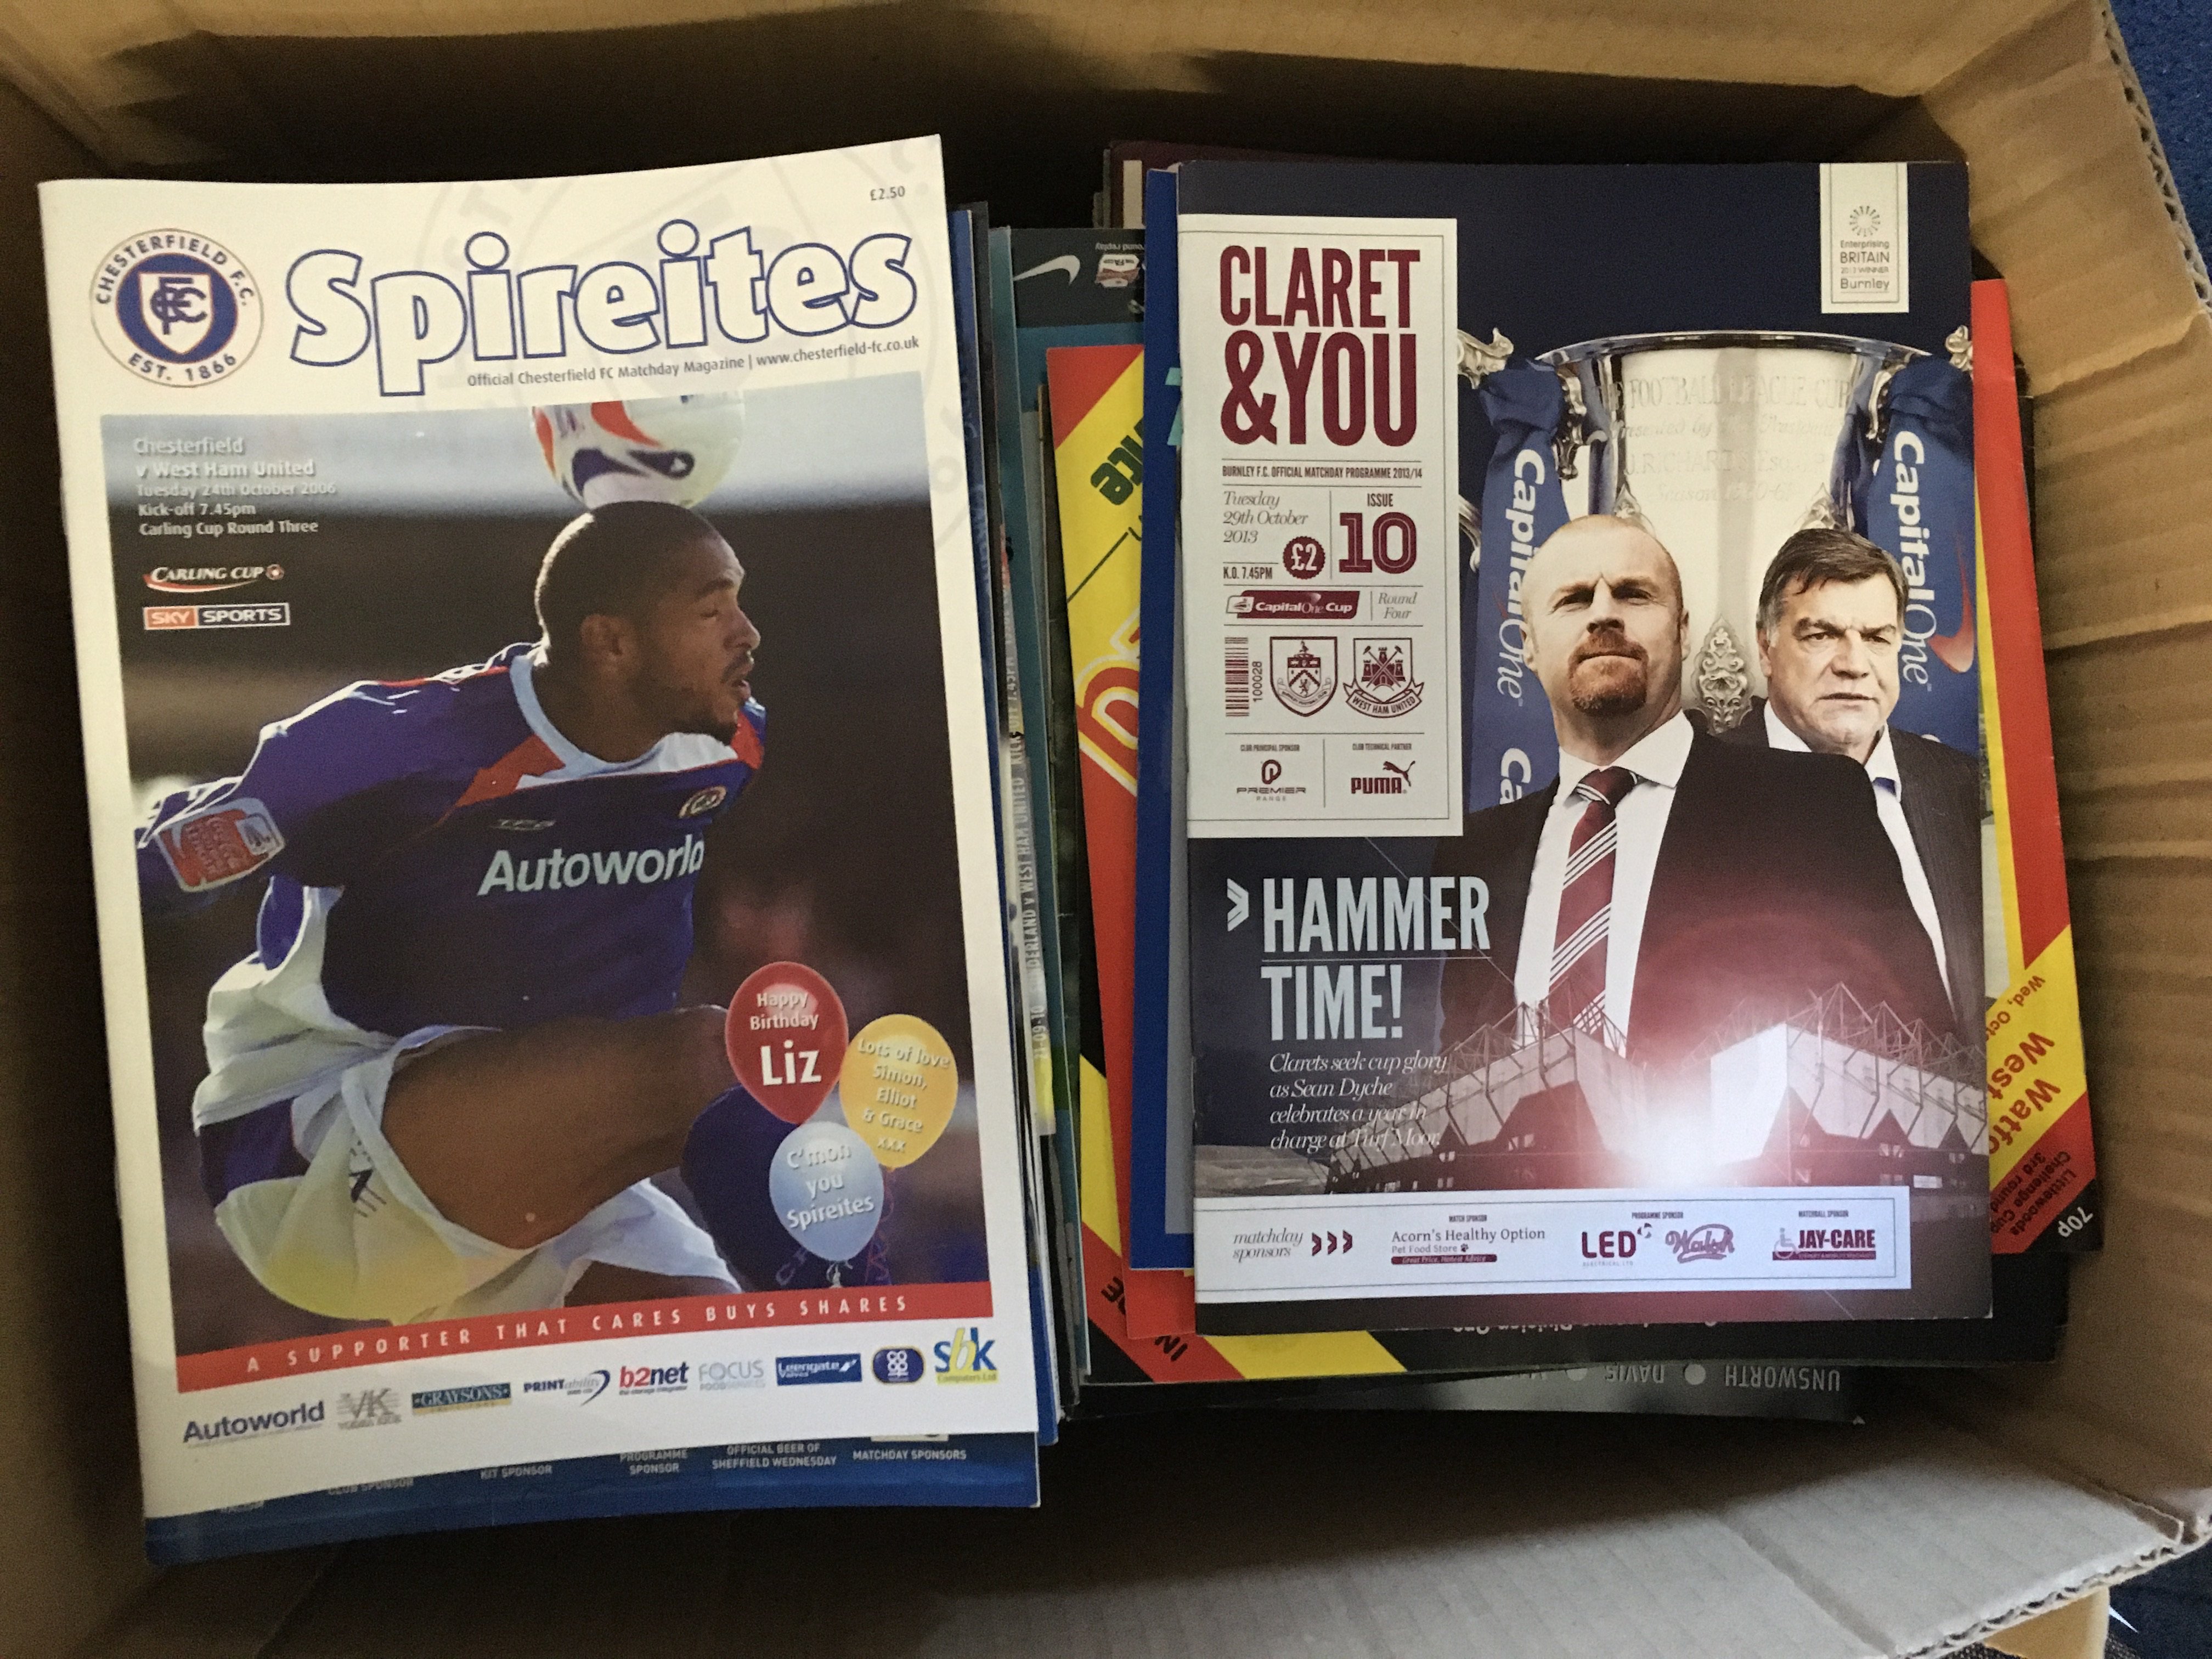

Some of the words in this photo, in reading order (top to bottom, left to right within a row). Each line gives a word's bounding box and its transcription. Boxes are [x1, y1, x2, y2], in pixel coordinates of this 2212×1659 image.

[870, 184, 905, 201] £2.50
[1841, 240, 1890, 250] Enterprising
[1841, 251, 1890, 263] BRITAIN
[95, 234, 227, 306] CHESTERFIELD
[229, 269, 255, 307] F.C.
[1220, 244, 1421, 329] CLARET
[1841, 278, 1890, 290] Burnley
[285, 218, 917, 397] Spireites
[127, 351, 172, 382] EST.
[184, 352, 238, 382] 1866
[467, 372, 514, 387] Official
[518, 367, 596, 385] Chesterfield
[600, 367, 614, 379] FC
[618, 362, 680, 377] Matchday
[684, 357, 744, 374] Magazine
[756, 336, 919, 366] www.chesterfield-fc.co.uk
[1220, 329, 1417, 447] &YOU
[134, 437, 246, 456] Chesterfield
[135, 465, 149, 478] v
[153, 461, 199, 477] West
[204, 461, 248, 477] Ham
[253, 459, 317, 476] United
[1222, 465, 1255, 477] BURNLEY
[1256, 466, 1270, 478] F.C.
[1271, 466, 1303, 478] OFFICIAL
[1305, 467, 1344, 478] MATCHDAY
[1346, 467, 1391, 479] PROGRAMME
[1392, 467, 1423, 479] 2013/14
[137, 483, 197, 499] Tuesday
[204, 483, 236, 496] 24th
[240, 483, 296, 496] October
[301, 482, 336, 495] 2006
[1223, 490, 1280, 510] Tuesday
[1367, 493, 1394, 507] ISSUE
[138, 502, 195, 516] Kick-off
[200, 502, 256, 518] 7.45pm
[1223, 509, 1254, 526] 29th
[1257, 509, 1309, 525] October
[139, 522, 193, 539] Carling
[196, 521, 223, 538] Cup
[228, 520, 274, 535] Round
[278, 519, 319, 533] Three
[1223, 530, 1259, 544] 2013
[1339, 512, 1417, 574] 10
[1290, 543, 1318, 571] £2
[150, 566, 227, 583] CARLING
[230, 565, 265, 579] CUP
[1223, 566, 1239, 580] K.O.
[1242, 566, 1273, 580] 7.45PM
[1325, 602, 1353, 614] Cup
[1378, 592, 1419, 606] Round
[151, 611, 191, 625] SKY
[202, 607, 282, 623] SPORTS
[1383, 607, 1412, 620] Four
[1252, 660, 1263, 703] 100028
[1352, 696, 1372, 714] WEST
[1372, 702, 1390, 715] HAM
[1390, 696, 1416, 714] UNITED
[1235, 786, 1306, 794] PREMIER
[1351, 777, 1402, 794] PUMA
[1015, 826, 1031, 856] HAM
[1019, 861, 1036, 894] WEST
[1263, 876, 1491, 953] HAMMER
[757, 991, 809, 1009] Happy
[1261, 963, 1403, 1041] TIME!
[2007, 974, 2046, 1008] Wed,
[748, 1013, 819, 1032] Birthday
[760, 1039, 822, 1087] Liz
[857, 1037, 891, 1059] Lots
[895, 1039, 915, 1061] of
[916, 1046, 951, 1070] love
[1269, 1052, 1329, 1073] Clarets
[1331, 1051, 1367, 1071] seek
[1368, 1055, 1401, 1076] cup
[1401, 1049, 1448, 1075] glory
[871, 1064, 928, 1090] Simon,
[1987, 1031, 2056, 1101] West
[876, 1086, 917, 1109] Elliot
[1269, 1084, 1289, 1098] as
[1290, 1078, 1334, 1098] Sean
[1338, 1075, 1394, 1102] Dyche
[861, 1107, 876, 1124] &
[879, 1112, 924, 1134] Grace
[1269, 1103, 1350, 1125] celebrates
[1351, 1108, 1364, 1122] a
[1368, 1108, 1406, 1125] year
[1408, 1104, 1427, 1121] in
[877, 1136, 907, 1154] xxx
[1269, 1128, 1328, 1154] charge
[1328, 1131, 1347, 1149] at
[786, 1143, 852, 1171] C'mon
[805, 1175, 845, 1200] you
[2009, 1168, 2077, 1236] Littlewoods
[786, 1194, 875, 1233] Spireites
[2057, 1206, 2094, 1238] 70p
[1233, 1228, 1304, 1246] matchday
[1391, 1228, 1442, 1243] Acorn's
[1445, 1227, 1497, 1244] Healthy
[1500, 1227, 1546, 1243] Option
[1581, 1230, 1637, 1259] LED
[1798, 1228, 1876, 1249] JAY-CARE
[1232, 1246, 1292, 1263] sponsors
[1391, 1245, 1406, 1254] Pet
[1408, 1244, 1431, 1254] Food
[1433, 1244, 1458, 1252] Store
[247, 1357, 259, 1373] A
[287, 1329, 471, 1367] SUPPORTER
[496, 1318, 568, 1340] THAT
[591, 1307, 682, 1332] CARES
[706, 1301, 776, 1322] BUYS
[799, 1295, 909, 1317] SHARES
[934, 1327, 998, 1373] sbk
[619, 1361, 690, 1389] b2net
[698, 1359, 765, 1381] FOCUS
[1725, 1364, 1841, 1392] UNSWORTH
[420, 1384, 503, 1407] GRAYSONS
[183, 1400, 325, 1443] Autoworld
[727, 1443, 774, 1455] OFFICIAL
[776, 1442, 804, 1454] BEER
[806, 1442, 820, 1453] OF
[853, 1448, 909, 1461] MATCHDAY
[911, 1448, 967, 1460] SPONSORS
[500, 1464, 553, 1479] SPONSOR
[630, 1463, 680, 1475] SPONSOR
[712, 1457, 769, 1470] SHEFFIELD
[772, 1455, 837, 1468] WEDNESDAY
